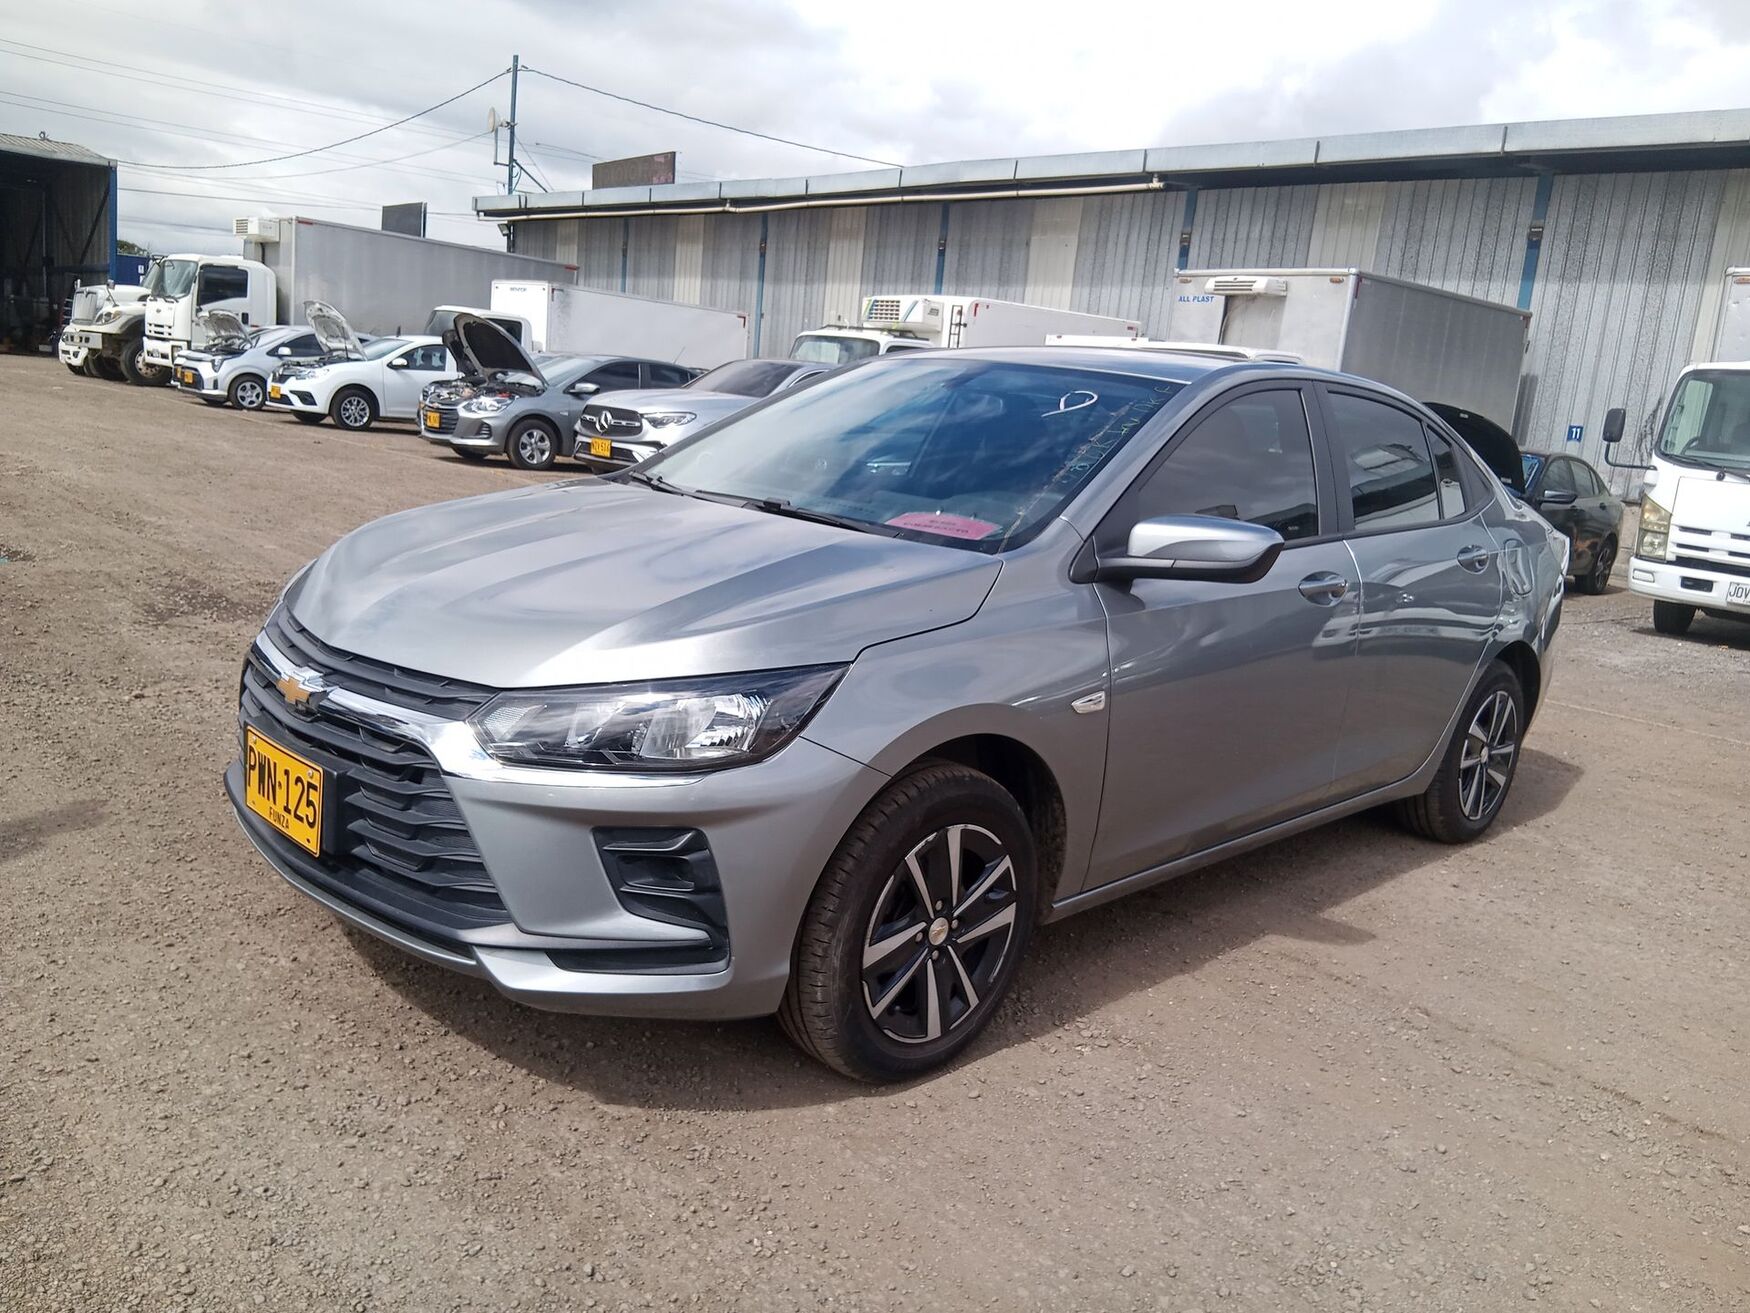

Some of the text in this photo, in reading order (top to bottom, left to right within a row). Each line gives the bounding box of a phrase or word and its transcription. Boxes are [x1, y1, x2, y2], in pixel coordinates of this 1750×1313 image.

[1178, 295, 1215, 303] ALL PLAST
[1571, 427, 1581, 439] 11
[268, 806, 290, 830] FUNZA
